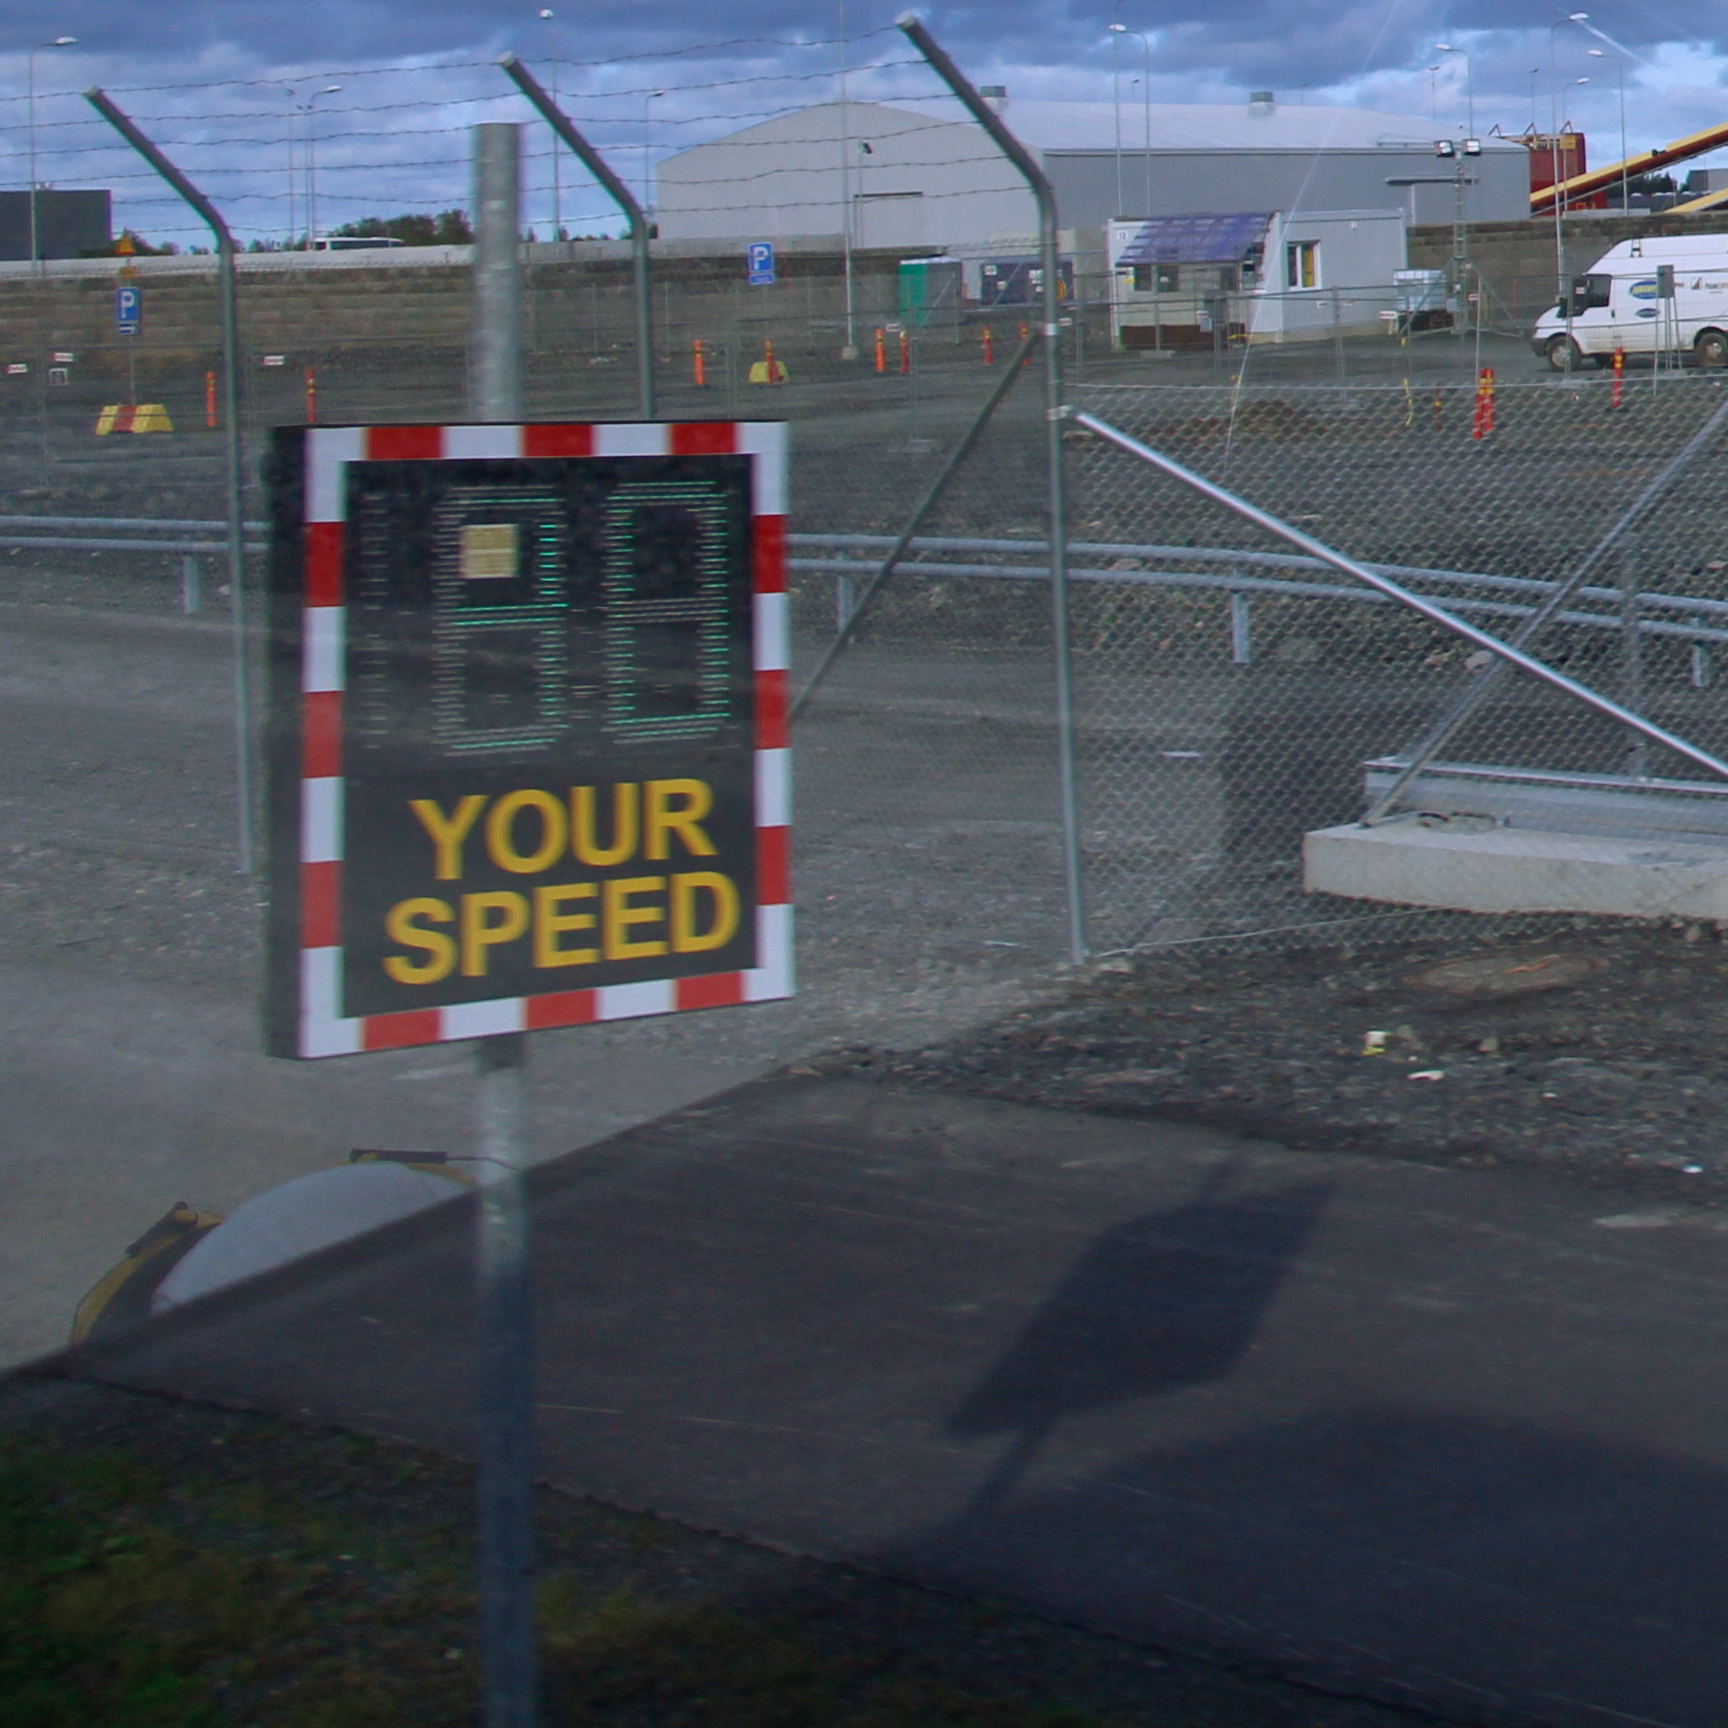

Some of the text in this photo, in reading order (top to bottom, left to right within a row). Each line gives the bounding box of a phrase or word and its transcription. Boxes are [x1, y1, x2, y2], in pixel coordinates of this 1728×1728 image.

[753, 246, 769, 270] P
[121, 291, 135, 319] P
[410, 778, 718, 880] YOUR
[383, 871, 741, 985] SPEED
